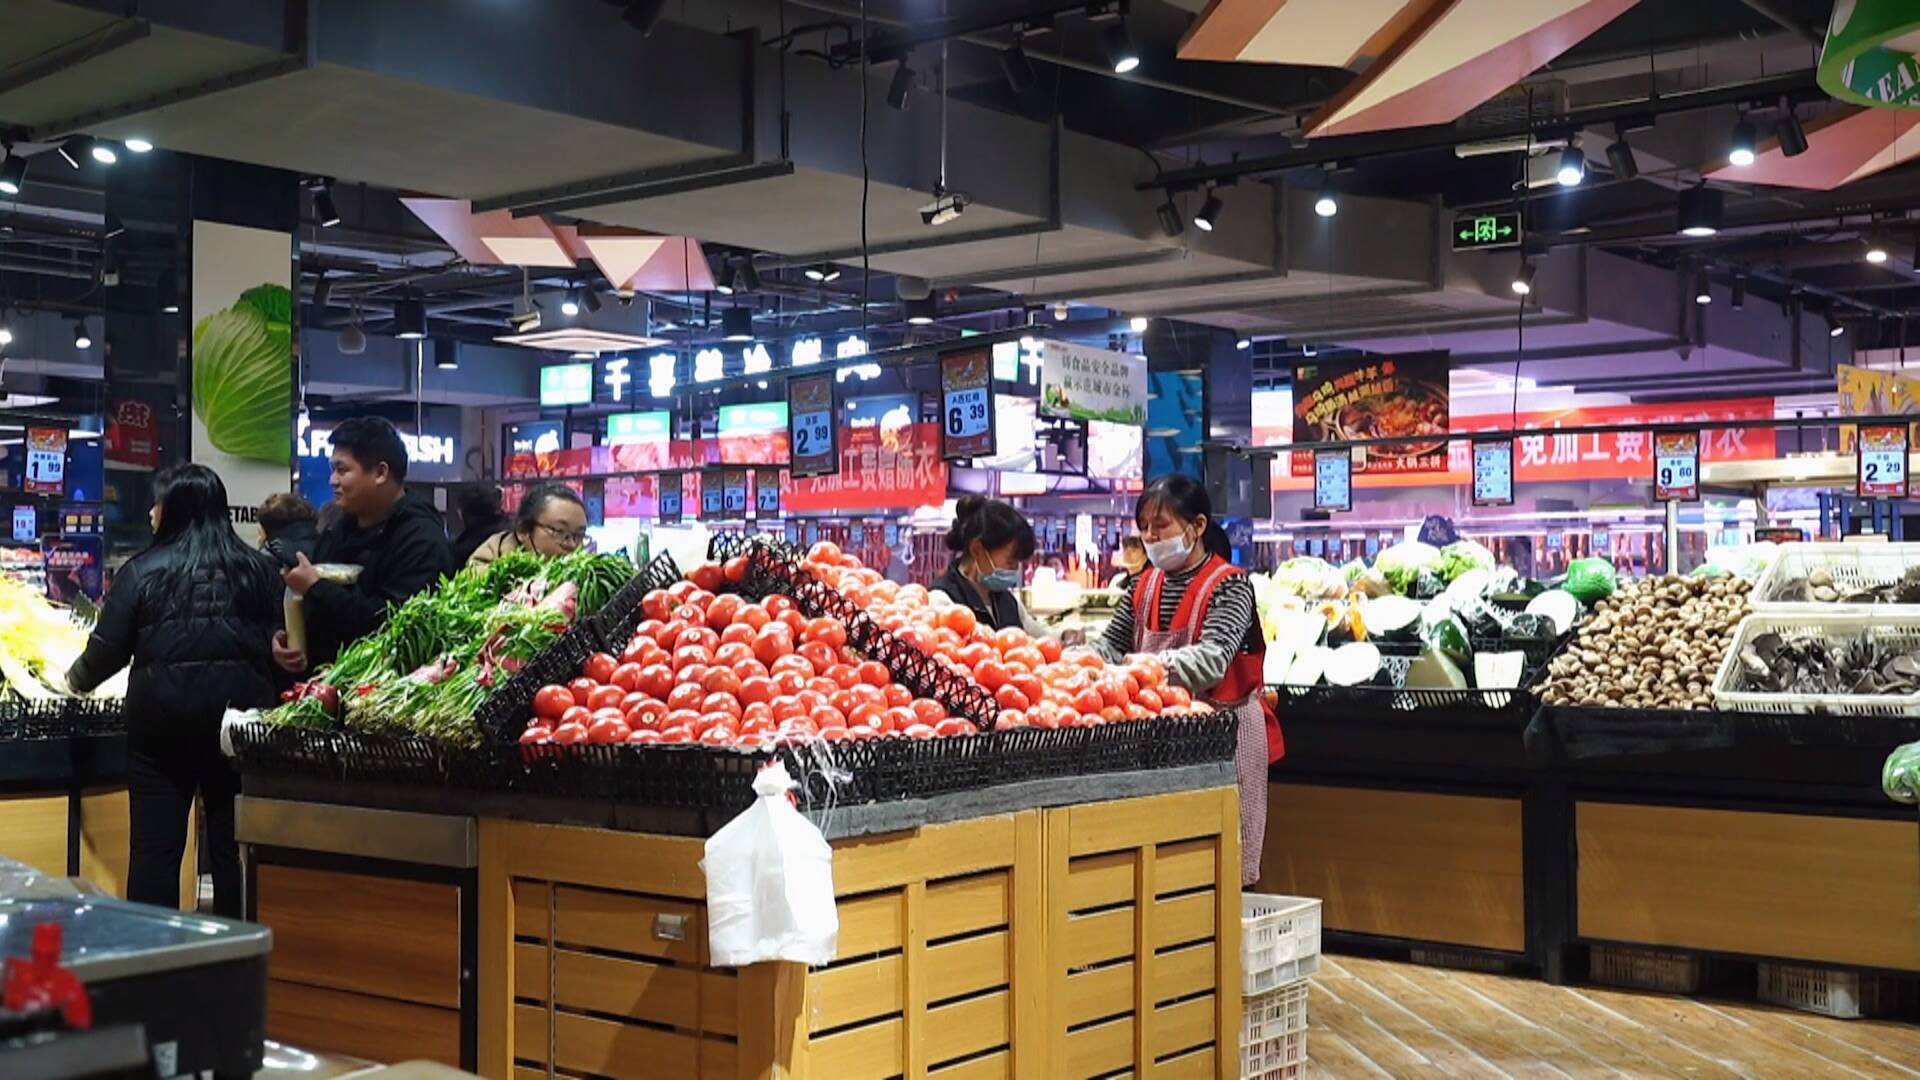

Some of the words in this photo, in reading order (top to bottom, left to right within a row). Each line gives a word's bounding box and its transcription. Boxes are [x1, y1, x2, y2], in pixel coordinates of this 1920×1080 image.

[949, 407, 963, 434] 6
[969, 403, 985, 420] 39
[797, 428, 809, 454] 2
[814, 425, 828, 441] 99
[31, 461, 39, 479] 1
[1661, 467, 1672, 486] 9
[1865, 463, 1878, 481] 2
[1886, 462, 1901, 473] 29
